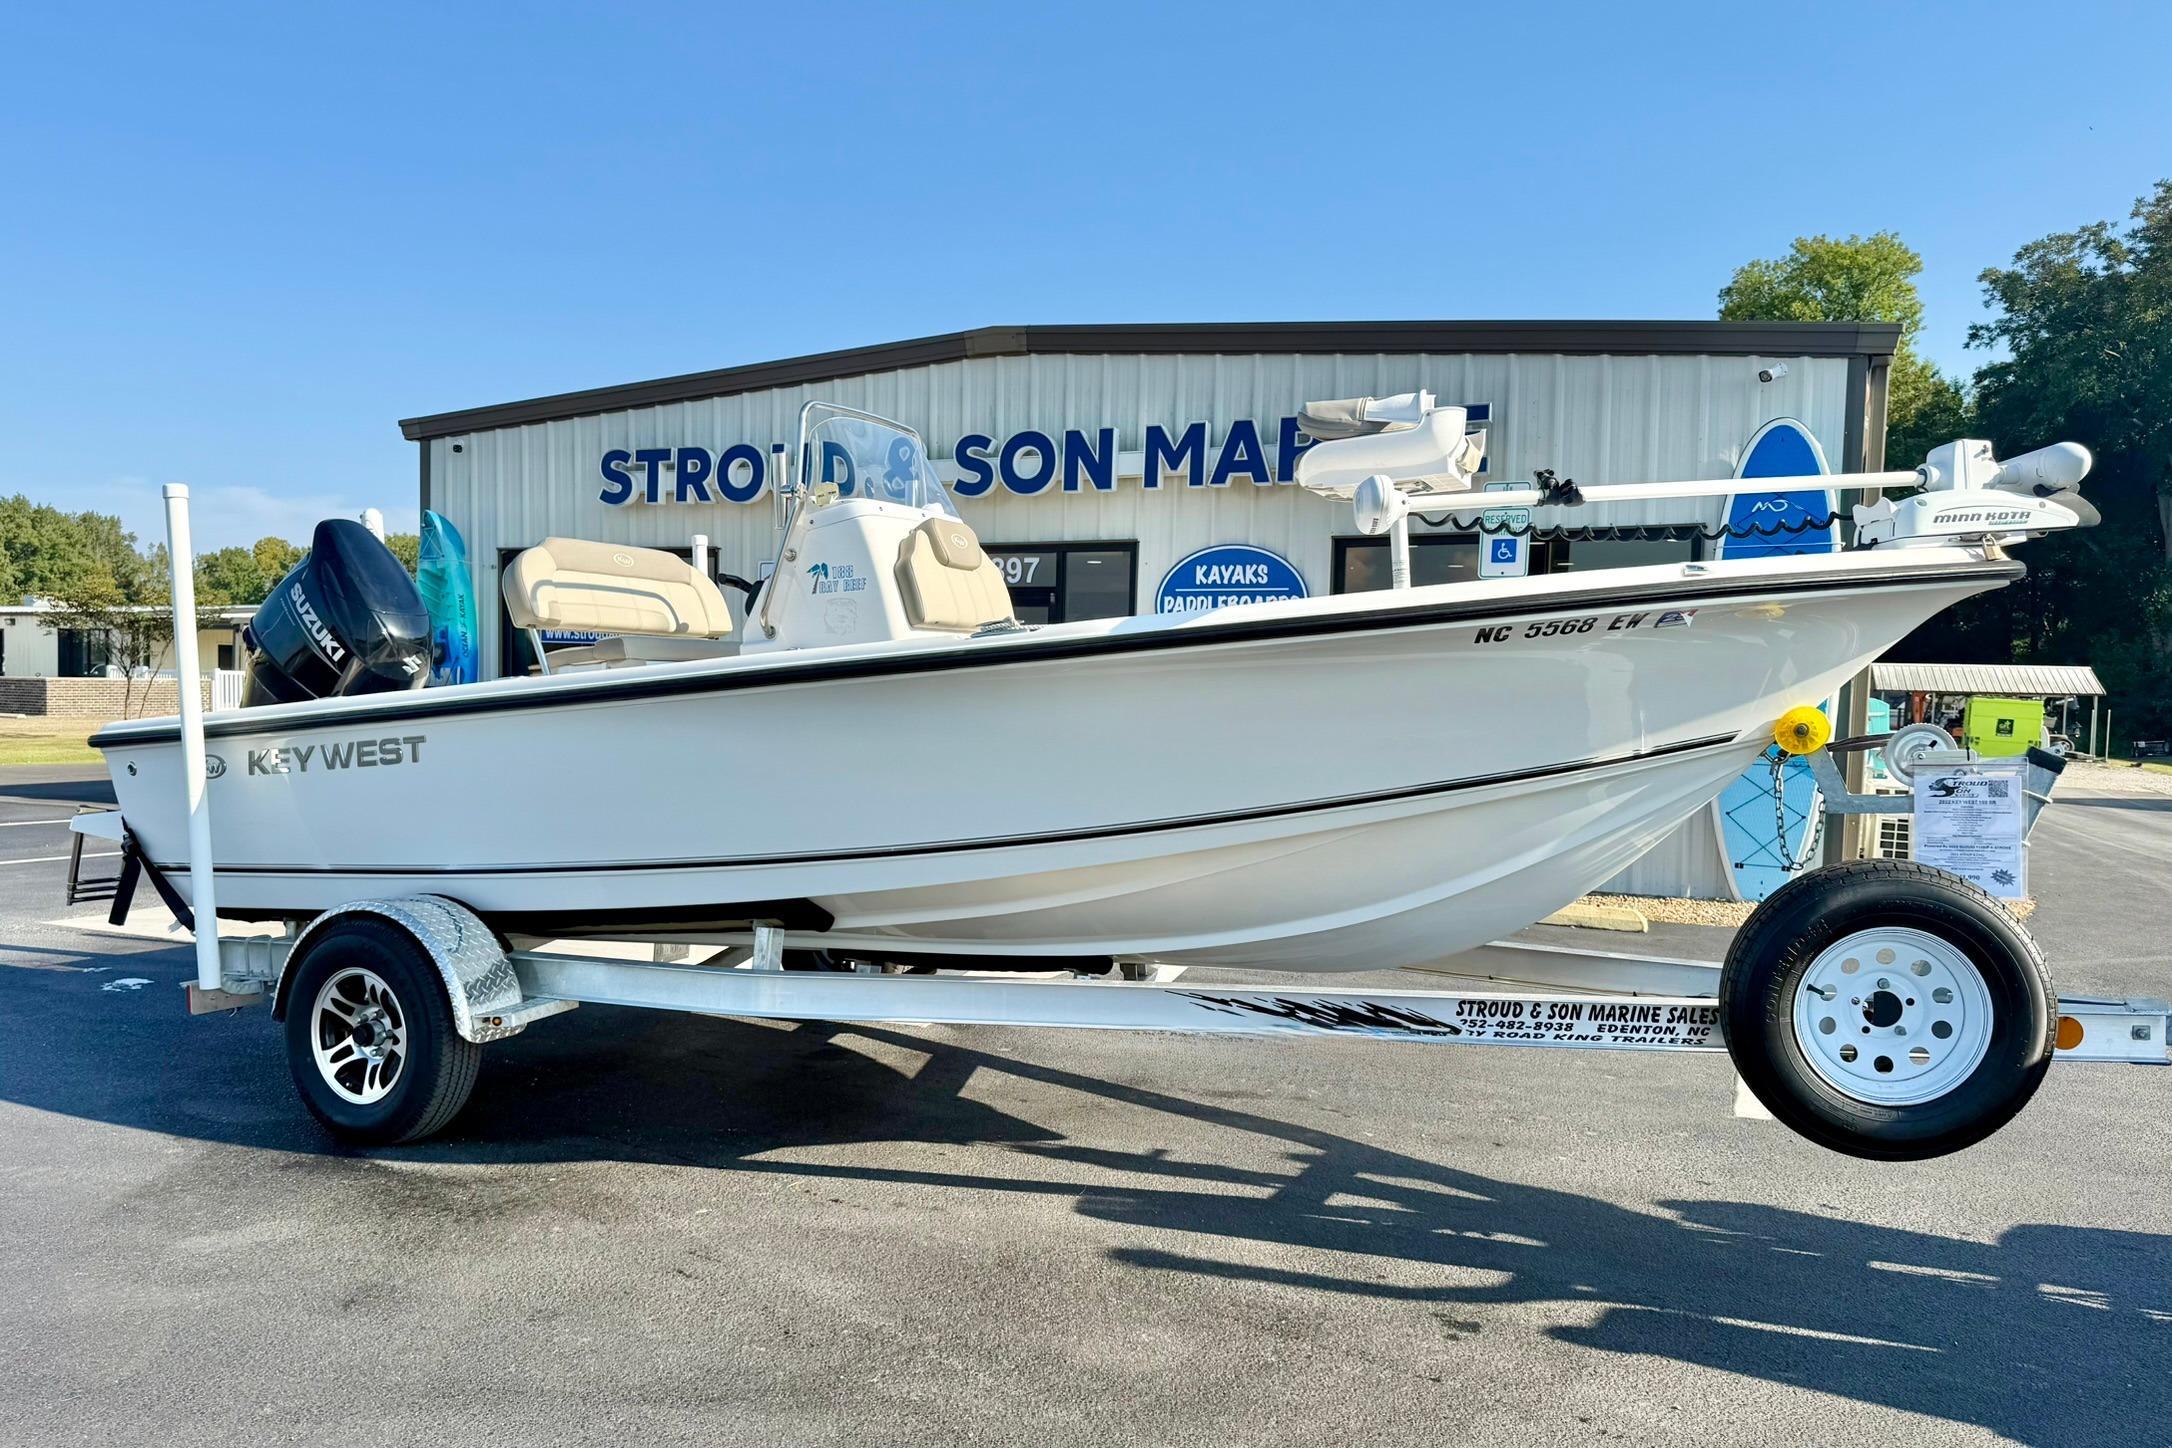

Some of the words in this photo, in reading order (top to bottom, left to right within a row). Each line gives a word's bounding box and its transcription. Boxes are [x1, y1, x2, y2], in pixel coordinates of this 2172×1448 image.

[881, 436, 921, 498] &
[954, 429, 1118, 498] SON
[1485, 514, 1527, 525] RESERVED
[1984, 511, 2031, 521] KOTA
[1195, 564, 1268, 585] KAYAKS
[290, 582, 346, 662] SUZUKI
[1474, 626, 1513, 644] NC
[1524, 617, 1598, 639] 5568
[248, 745, 315, 776] KEY
[320, 735, 427, 770] WEST
[1456, 1000, 1524, 1018] STROUD
[1530, 1002, 1541, 1019] &
[1547, 1003, 1583, 1021] SON
[1588, 1004, 1661, 1023] MARINE
[1667, 1006, 1720, 1025] SALES
[1493, 1031, 1546, 1039] ROAD
[1553, 1033, 1603, 1041] KING
[1611, 1036, 1706, 1045] TRAILERS
[1597, 1024, 1680, 1036] EDENTON,
[1687, 1027, 1711, 1036] NC
